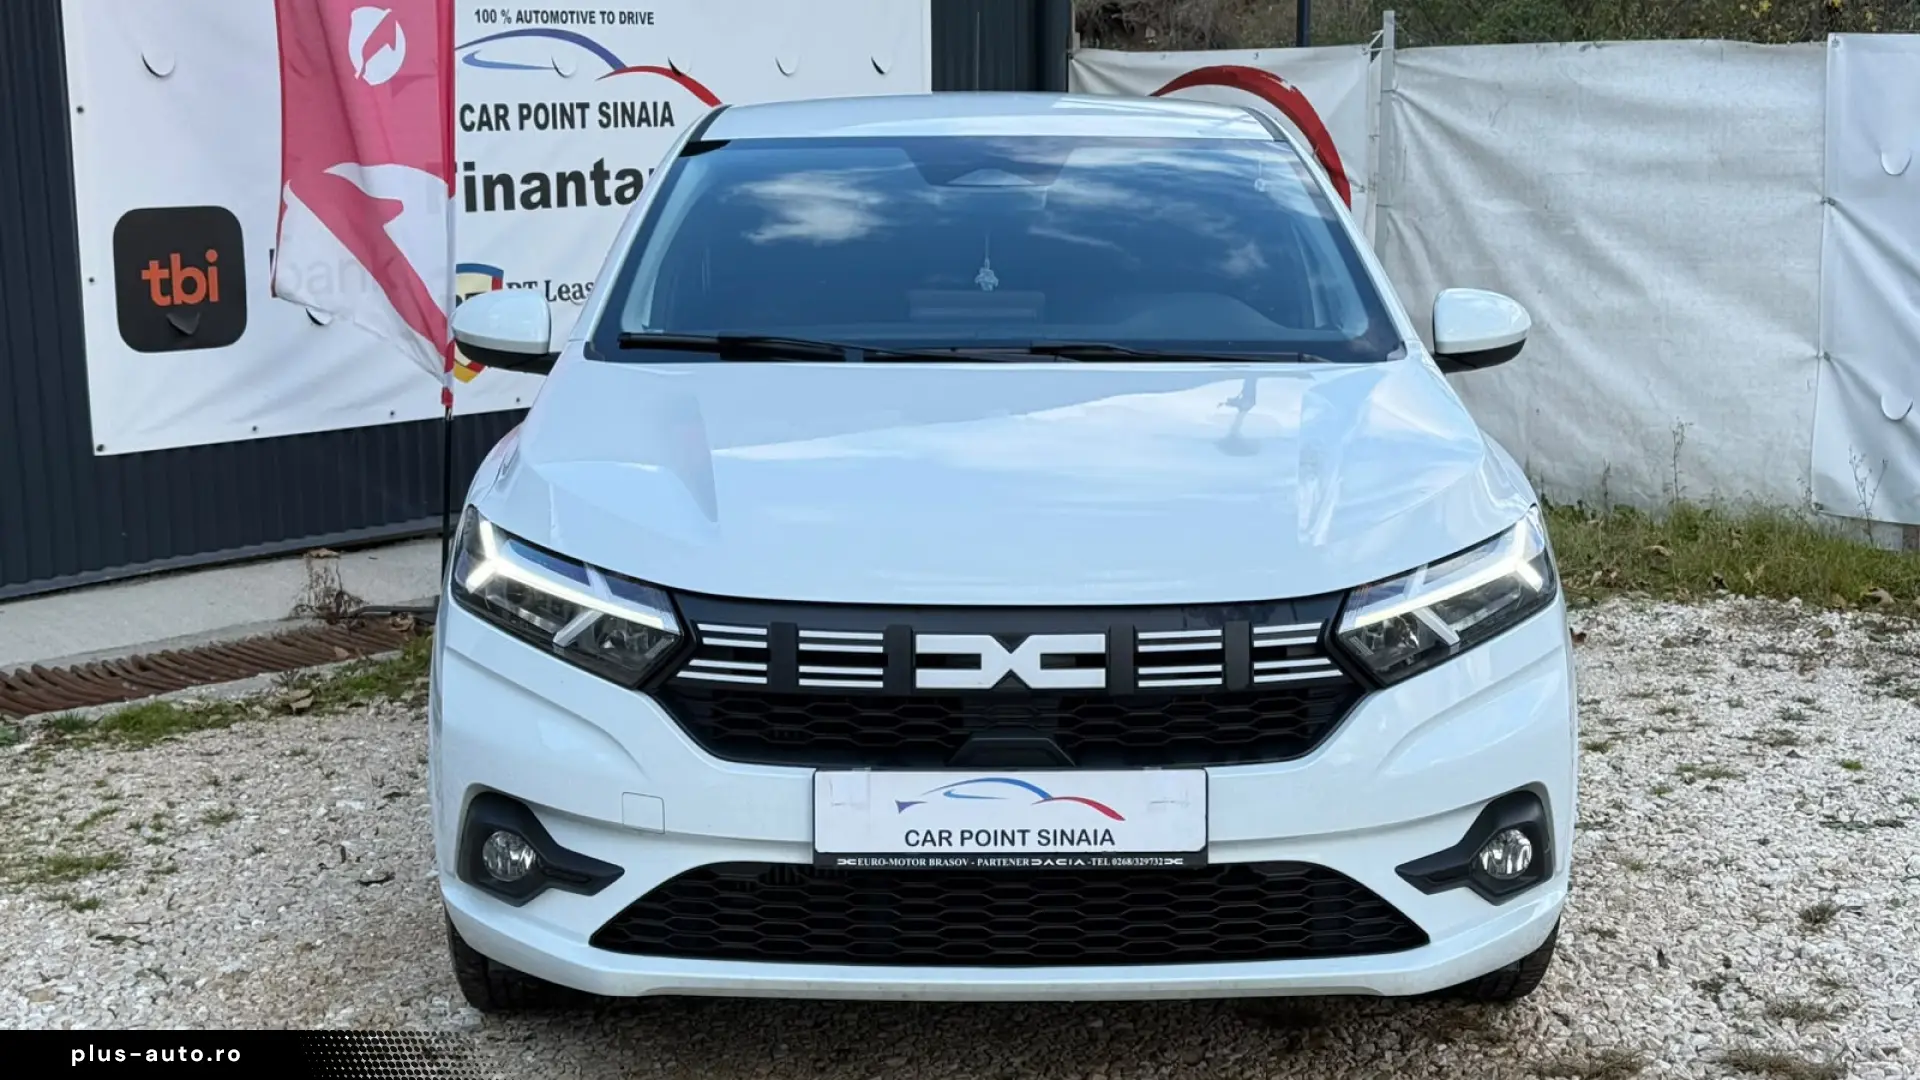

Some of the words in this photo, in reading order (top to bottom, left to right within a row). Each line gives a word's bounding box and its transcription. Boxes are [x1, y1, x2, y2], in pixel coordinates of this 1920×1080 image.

[474, 8, 498, 25] 100
[500, 9, 513, 25] %
[515, 9, 597, 25] AUTOMOTIVE
[599, 10, 616, 25] TO
[618, 11, 655, 26] DRIVE
[459, 103, 511, 132] CAR
[518, 102, 590, 131] POINT
[598, 101, 675, 129] SINAIA
[453, 157, 654, 213] inanta
[141, 248, 220, 307] tbi
[904, 829, 953, 847] CAR
[959, 829, 1031, 847] POINT
[1036, 828, 1116, 847] SINAIA
[857, 857, 927, 867] EURO-MOTOR
[929, 857, 969, 867] BRASOV
[977, 857, 1030, 867] PARTENER
